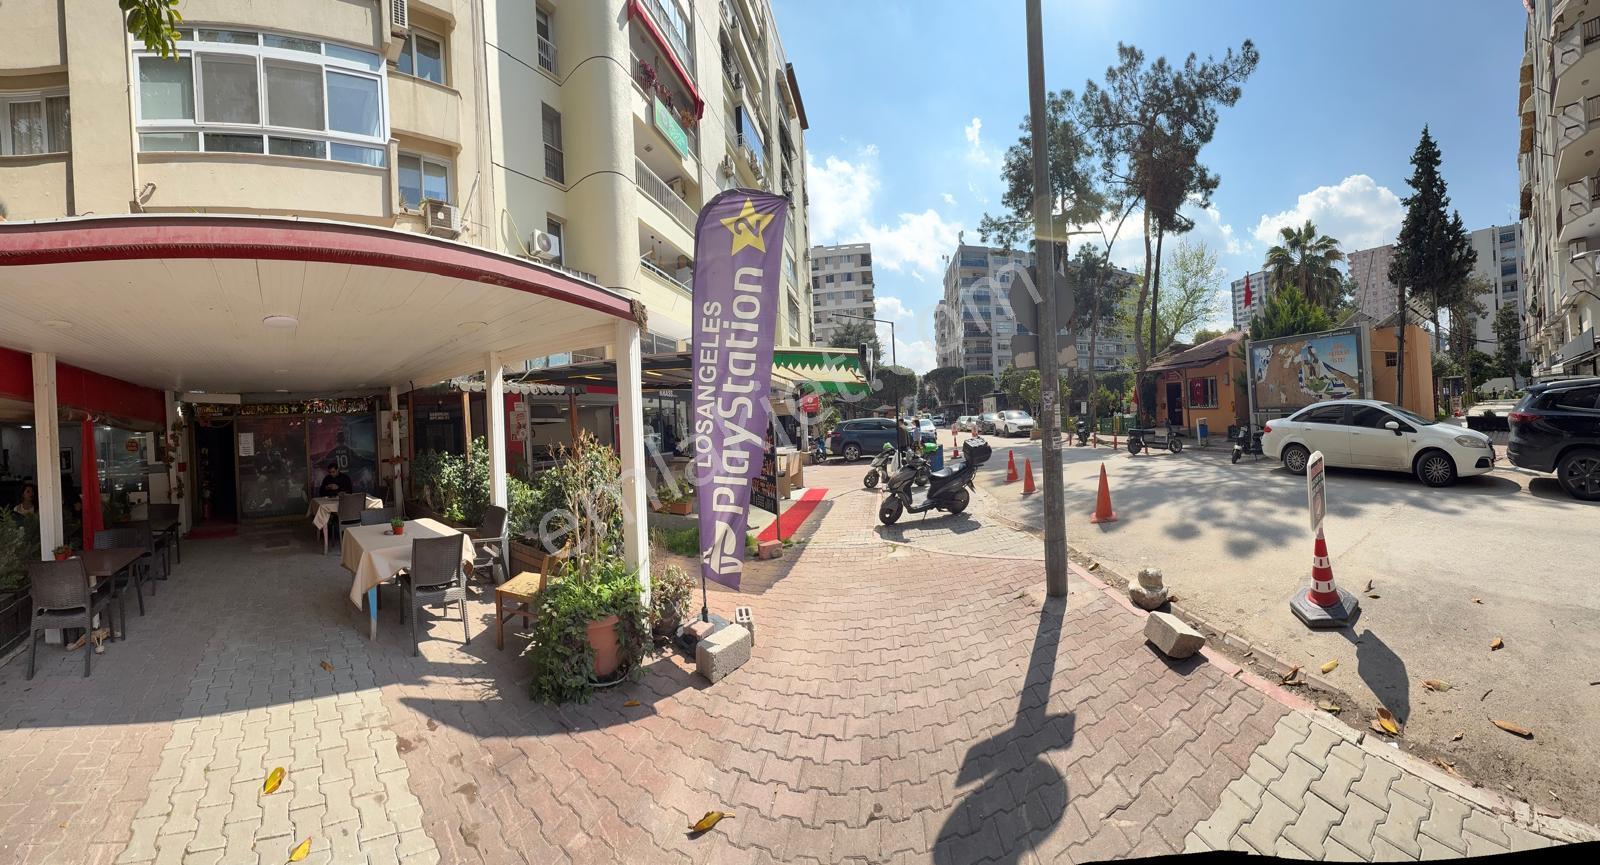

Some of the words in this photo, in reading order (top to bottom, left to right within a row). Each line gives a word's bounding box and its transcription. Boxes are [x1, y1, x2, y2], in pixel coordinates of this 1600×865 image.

[733, 217, 760, 238] 2
[695, 301, 722, 468] LOSANGELES
[713, 266, 764, 515] PlayStation
